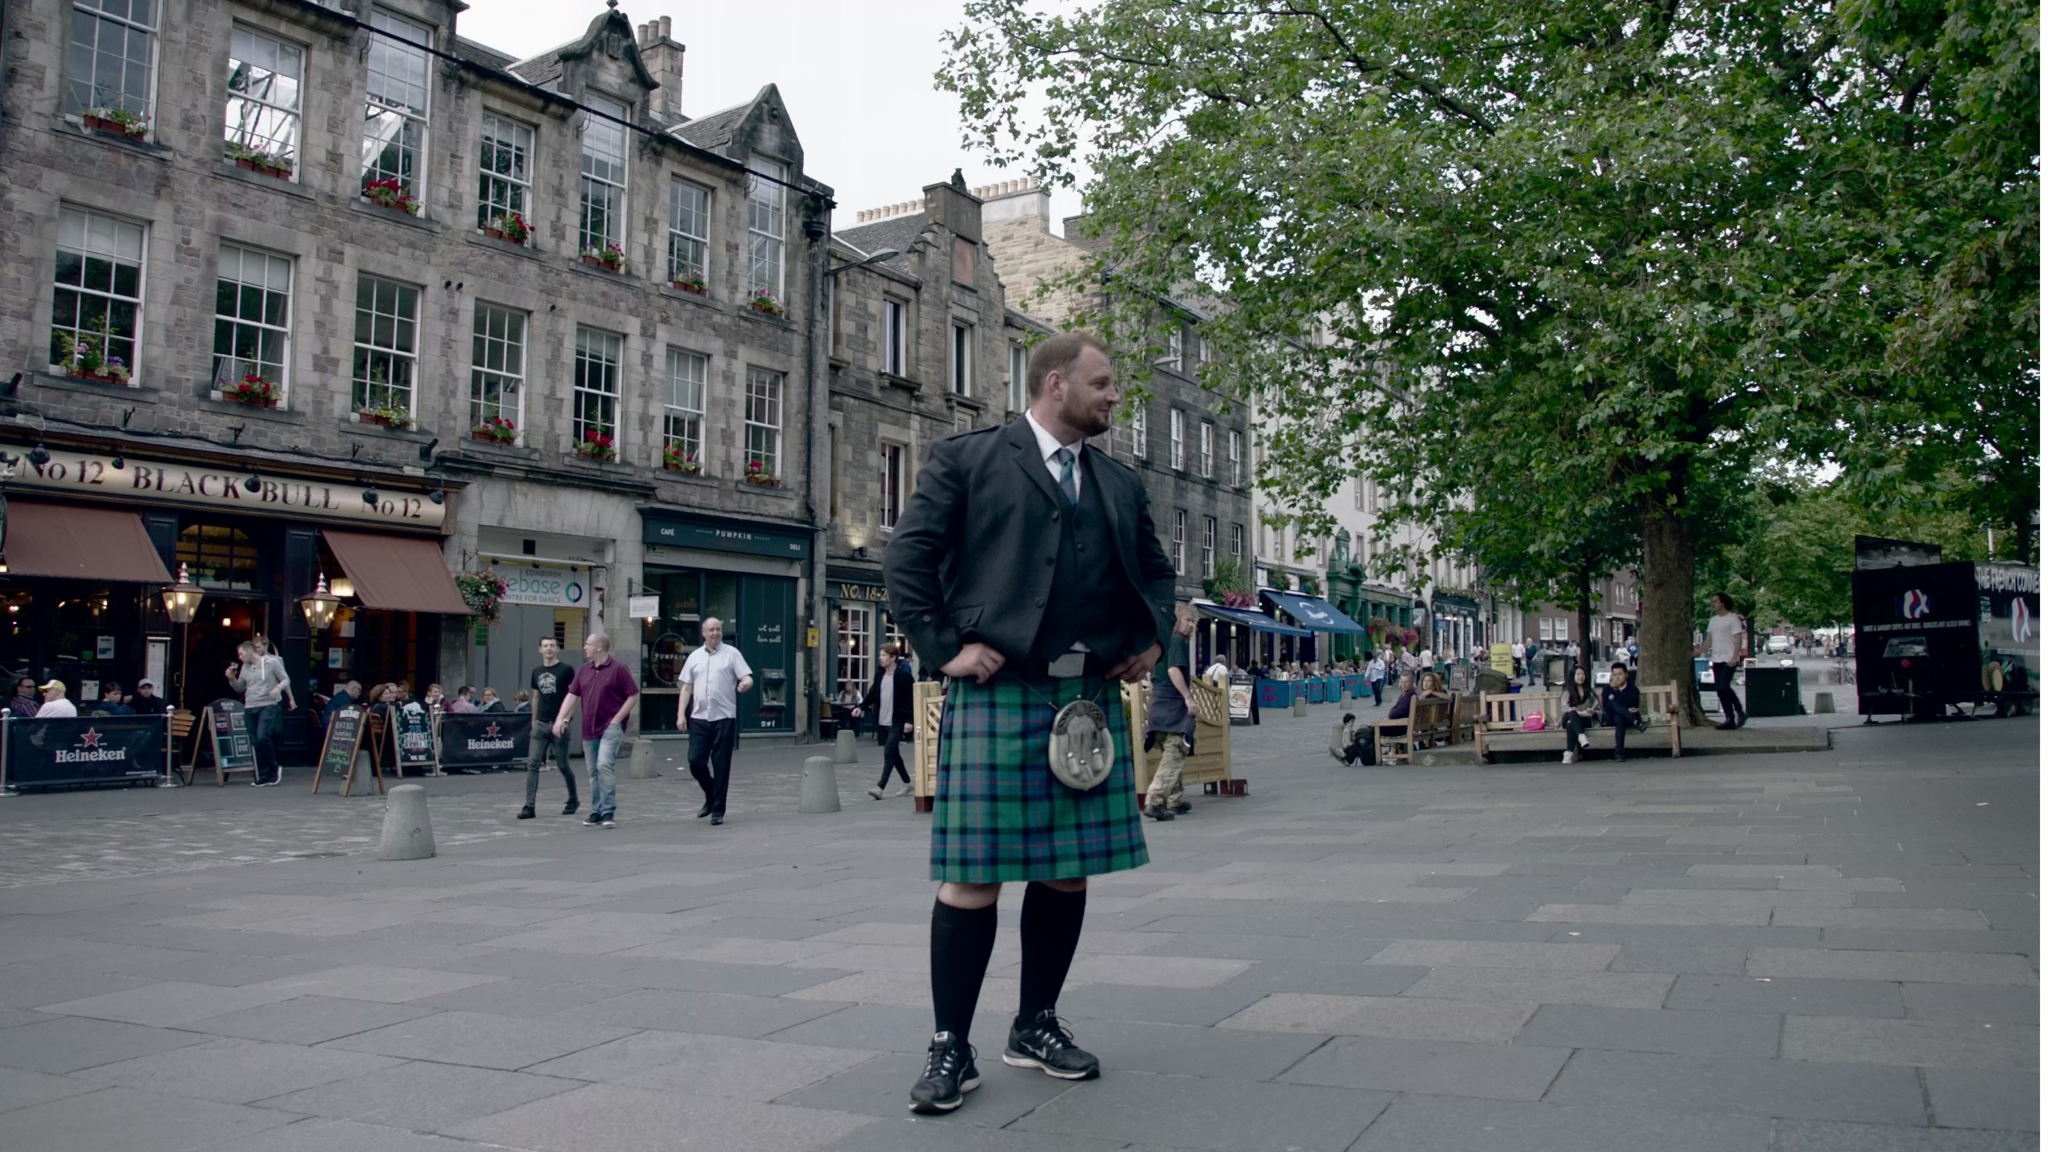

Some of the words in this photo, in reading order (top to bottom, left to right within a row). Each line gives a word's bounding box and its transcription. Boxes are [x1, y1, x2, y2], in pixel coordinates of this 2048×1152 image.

[76, 460, 104, 485] 12
[133, 466, 241, 499] BLACK
[262, 481, 339, 510] BULL
[402, 497, 422, 518] 12
[715, 529, 752, 540] PUMPKIN
[789, 543, 801, 551] DELI
[525, 568, 562, 578] EDINBURGH
[1975, 566, 1991, 591] THE
[1991, 567, 2017, 593] FRENCH
[507, 568, 560, 595] ebase
[840, 583, 862, 599] NO.
[865, 585, 889, 601] 18-2
[525, 594, 538, 602] FOR
[539, 595, 561, 604] DANCE
[467, 739, 514, 750] Heineken
[55, 748, 126, 763] Heineken
